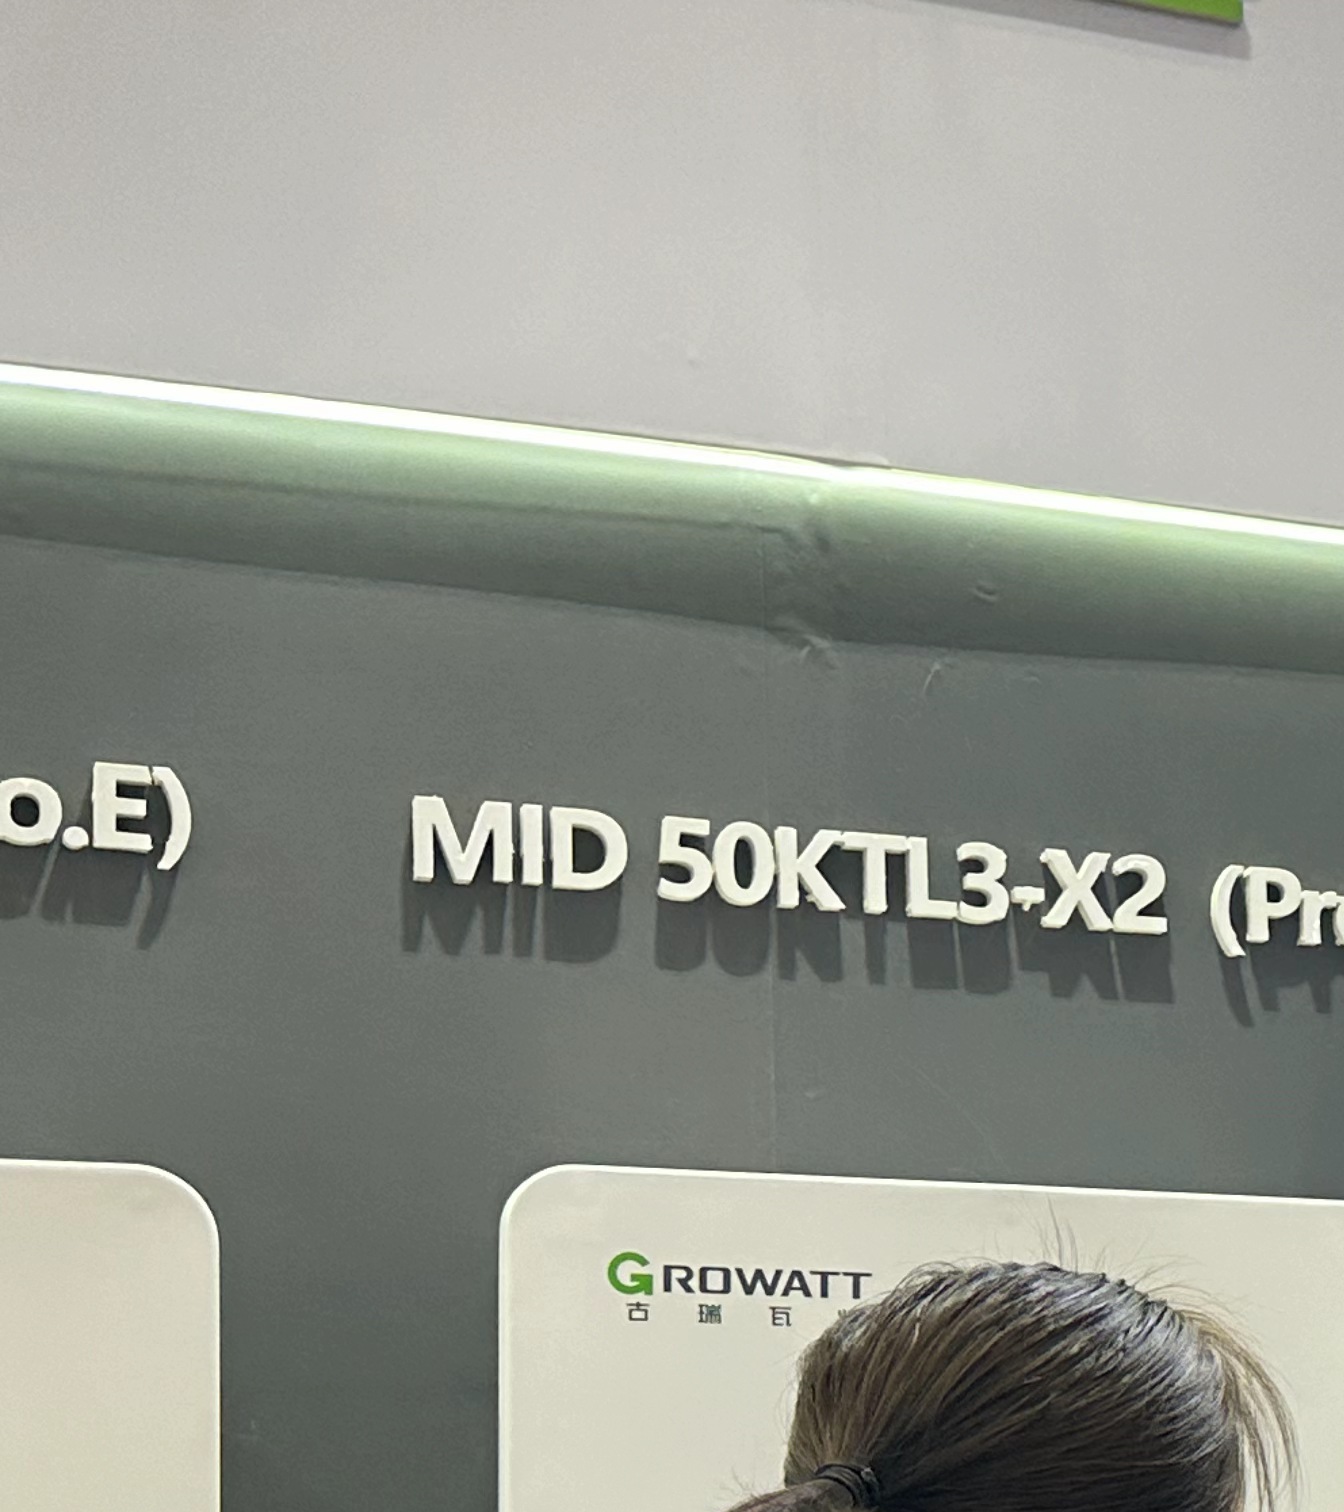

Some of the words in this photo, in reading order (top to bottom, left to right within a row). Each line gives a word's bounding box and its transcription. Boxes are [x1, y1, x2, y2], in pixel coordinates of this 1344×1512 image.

[410, 795, 629, 891] MID
[656, 815, 1169, 934] 50KTL3-X2
[607, 1251, 873, 1300] GROWATT
[626, 1301, 848, 1328] 古瑞瓦
